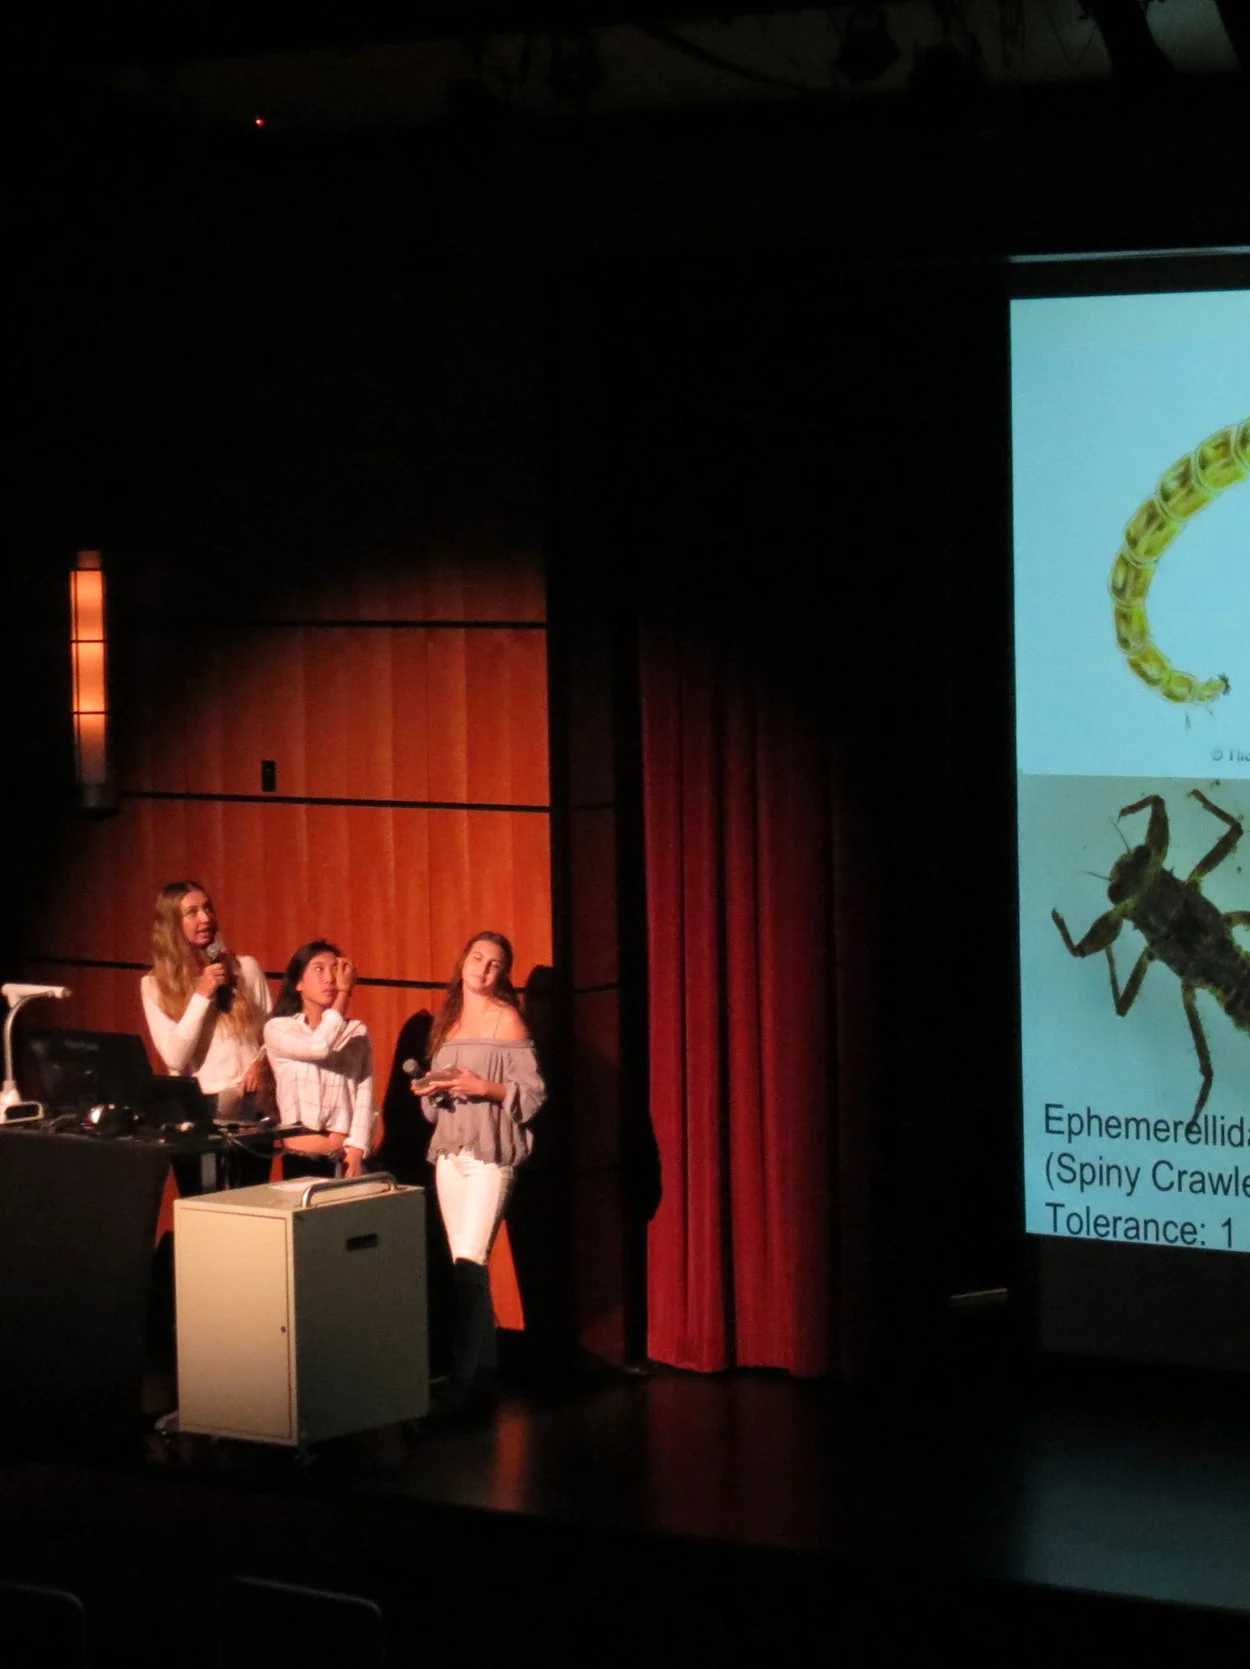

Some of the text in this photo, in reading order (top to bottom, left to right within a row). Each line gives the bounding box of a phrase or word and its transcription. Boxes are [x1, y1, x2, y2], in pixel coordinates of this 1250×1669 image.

[1045, 1151, 1141, 1197] (Spiny
[1045, 1202, 1234, 1248] Tolerance: 1
